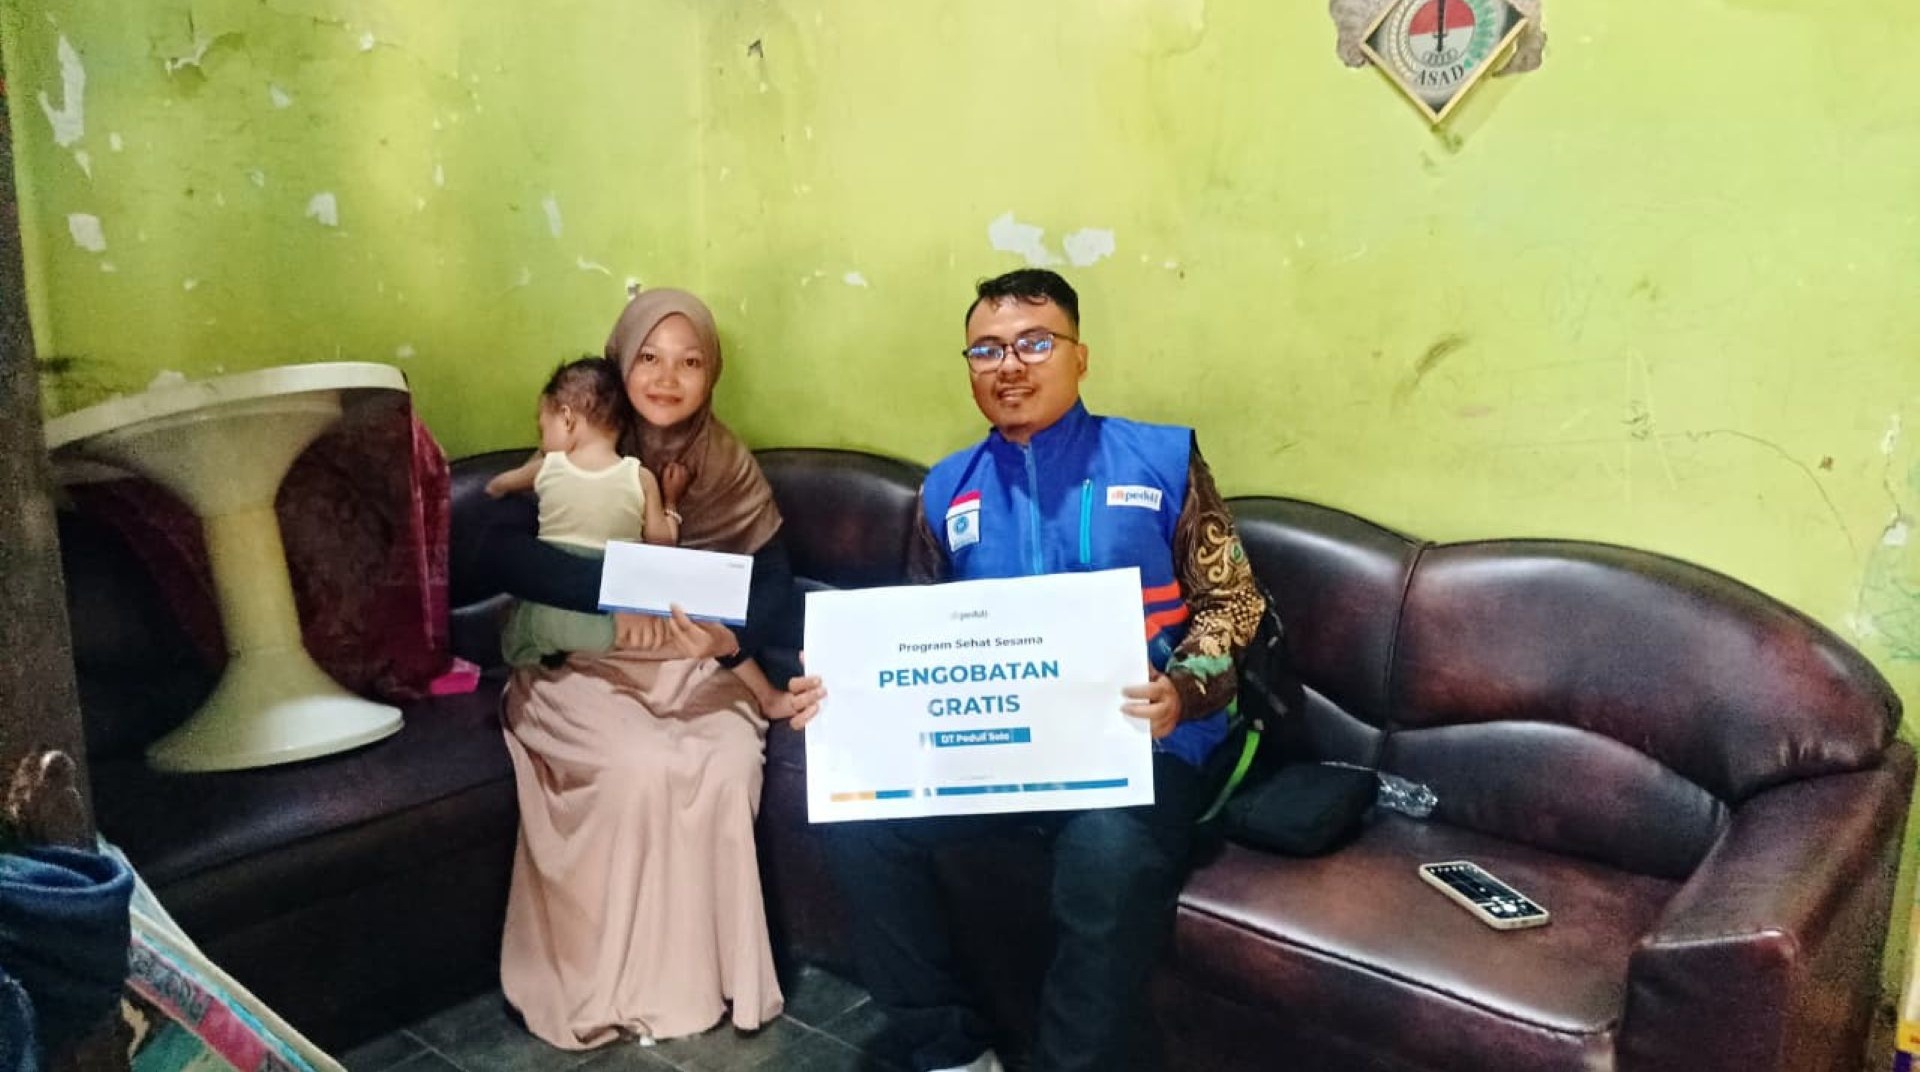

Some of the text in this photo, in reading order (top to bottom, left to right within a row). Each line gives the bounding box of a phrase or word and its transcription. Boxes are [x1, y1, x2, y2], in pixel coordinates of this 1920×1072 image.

[1415, 64, 1464, 86] ASAD
[899, 636, 1043, 653] Program Sehat Sesama
[878, 660, 1059, 688] PENGOBATAN
[927, 694, 1021, 717] GRATIS
